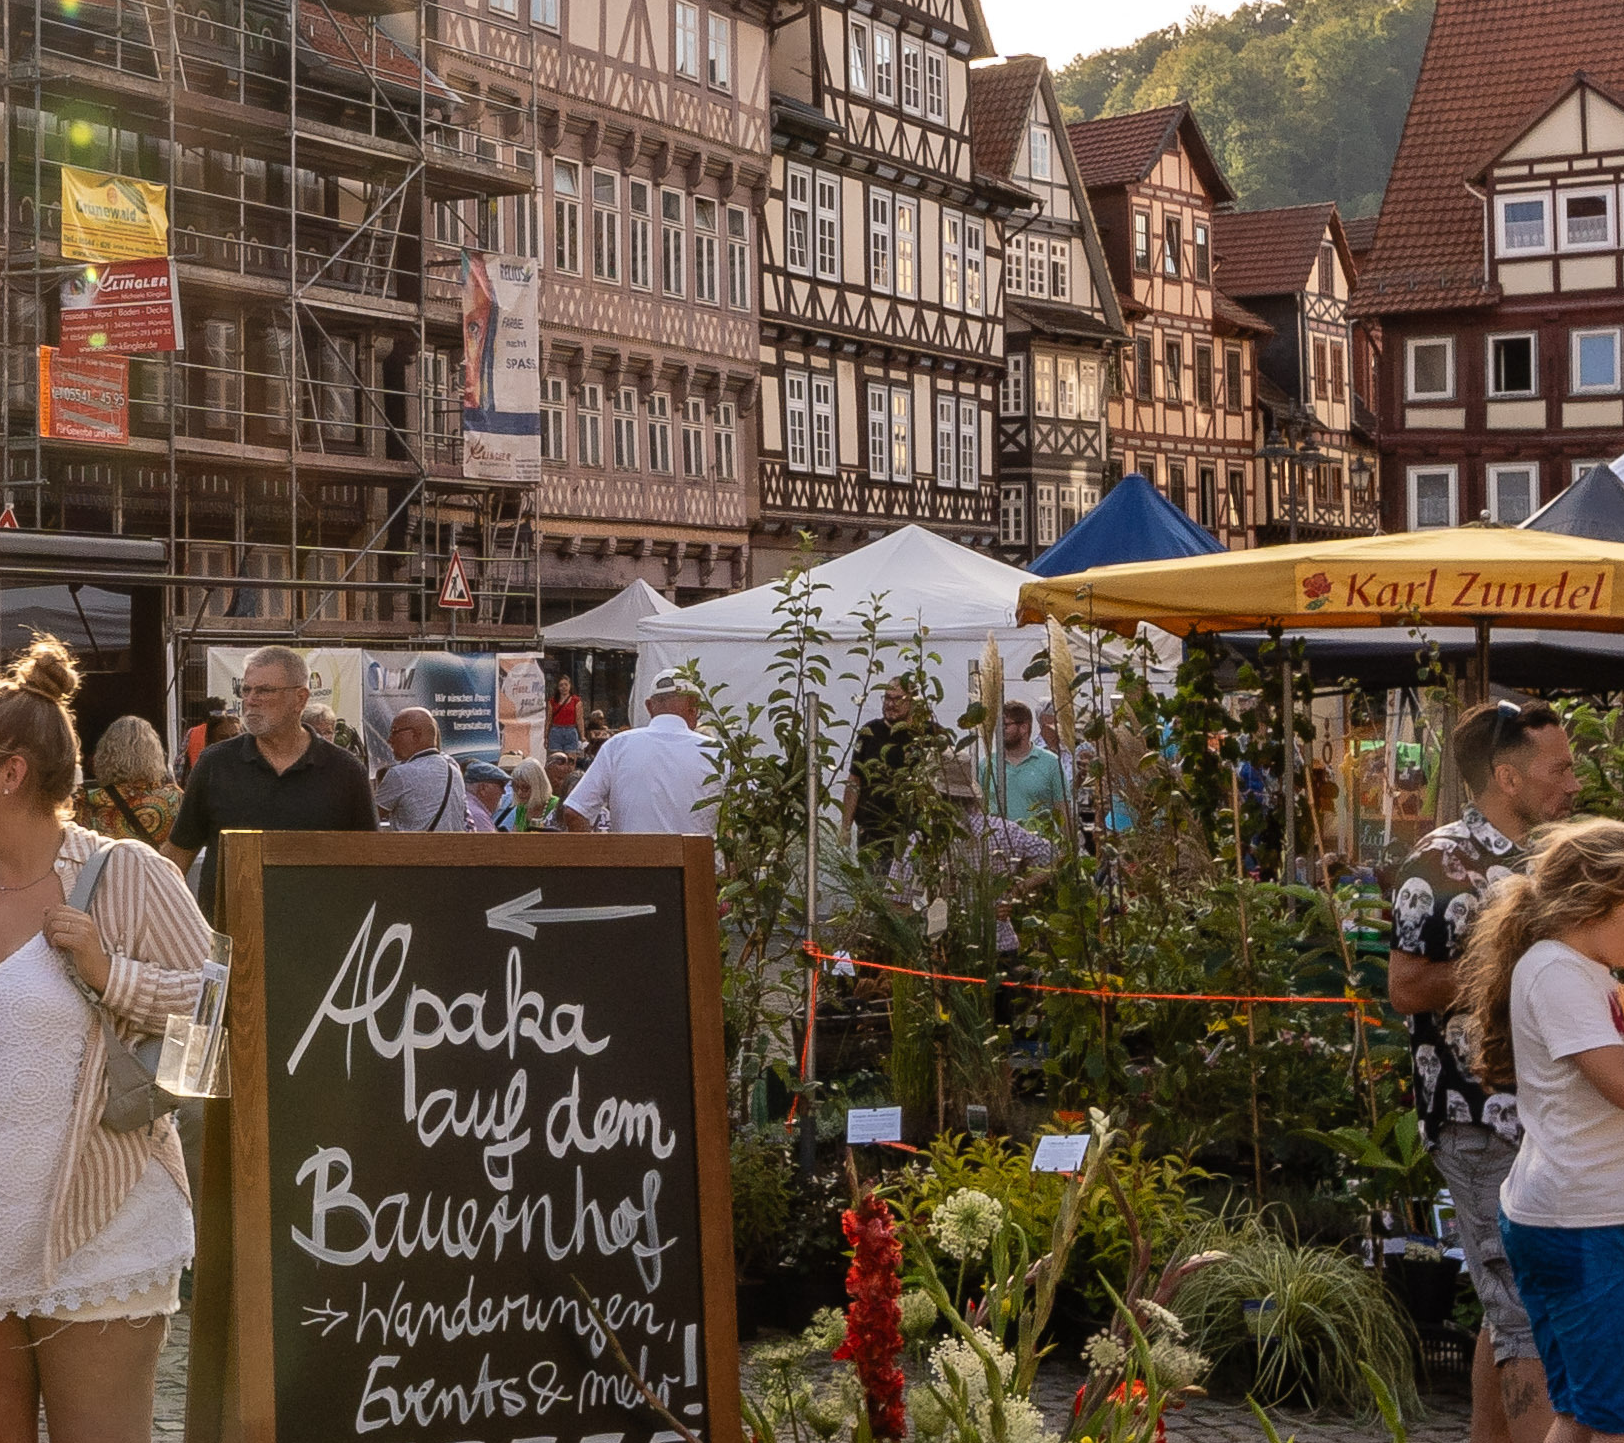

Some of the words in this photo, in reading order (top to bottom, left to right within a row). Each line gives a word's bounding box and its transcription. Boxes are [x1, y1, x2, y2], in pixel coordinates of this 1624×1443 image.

[95, 266, 168, 292] KLINGLER
[1346, 568, 1438, 608] Karl
[1451, 570, 1606, 611] Zundel
[288, 900, 610, 1124] Alpaka
[418, 1068, 532, 1192] auf
[547, 1066, 676, 1159] dem
[291, 1144, 678, 1294] Bauernhof
[356, 1275, 676, 1357] Wanderungen,
[356, 1354, 524, 1435] Events
